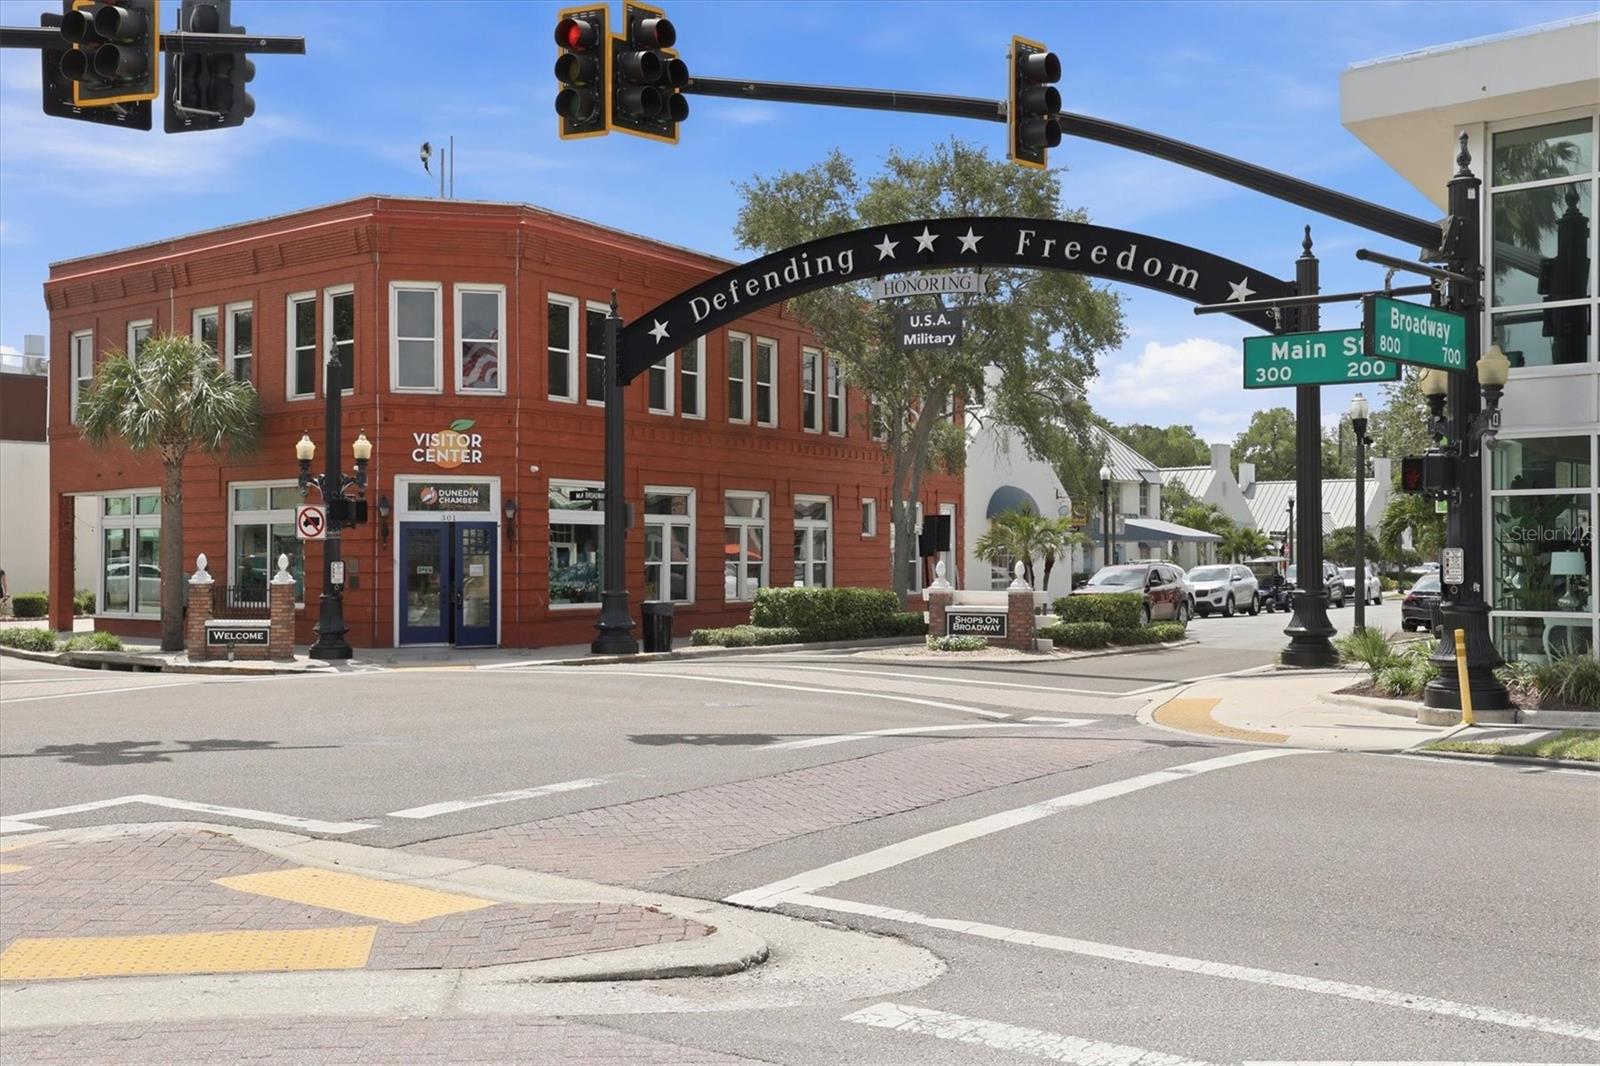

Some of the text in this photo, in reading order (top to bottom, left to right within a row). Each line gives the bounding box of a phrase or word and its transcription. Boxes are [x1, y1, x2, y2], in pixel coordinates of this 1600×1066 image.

[688, 229, 1200, 323] Defending Freedom
[884, 275, 971, 295] HONORING
[910, 314, 951, 327] U.S.A.
[1390, 307, 1450, 344] Broadway
[904, 333, 956, 346] Military
[1271, 340, 1326, 361] Main
[1379, 335, 1461, 365] 800 700
[1255, 360, 1386, 382] 300 200
[413, 432, 482, 448] VISITOR
[412, 448, 482, 463] CENTER
[953, 623, 1001, 631] BROADWAY
[954, 616, 999, 624] SHOPS ON
[213, 631, 264, 640] WELCOME
